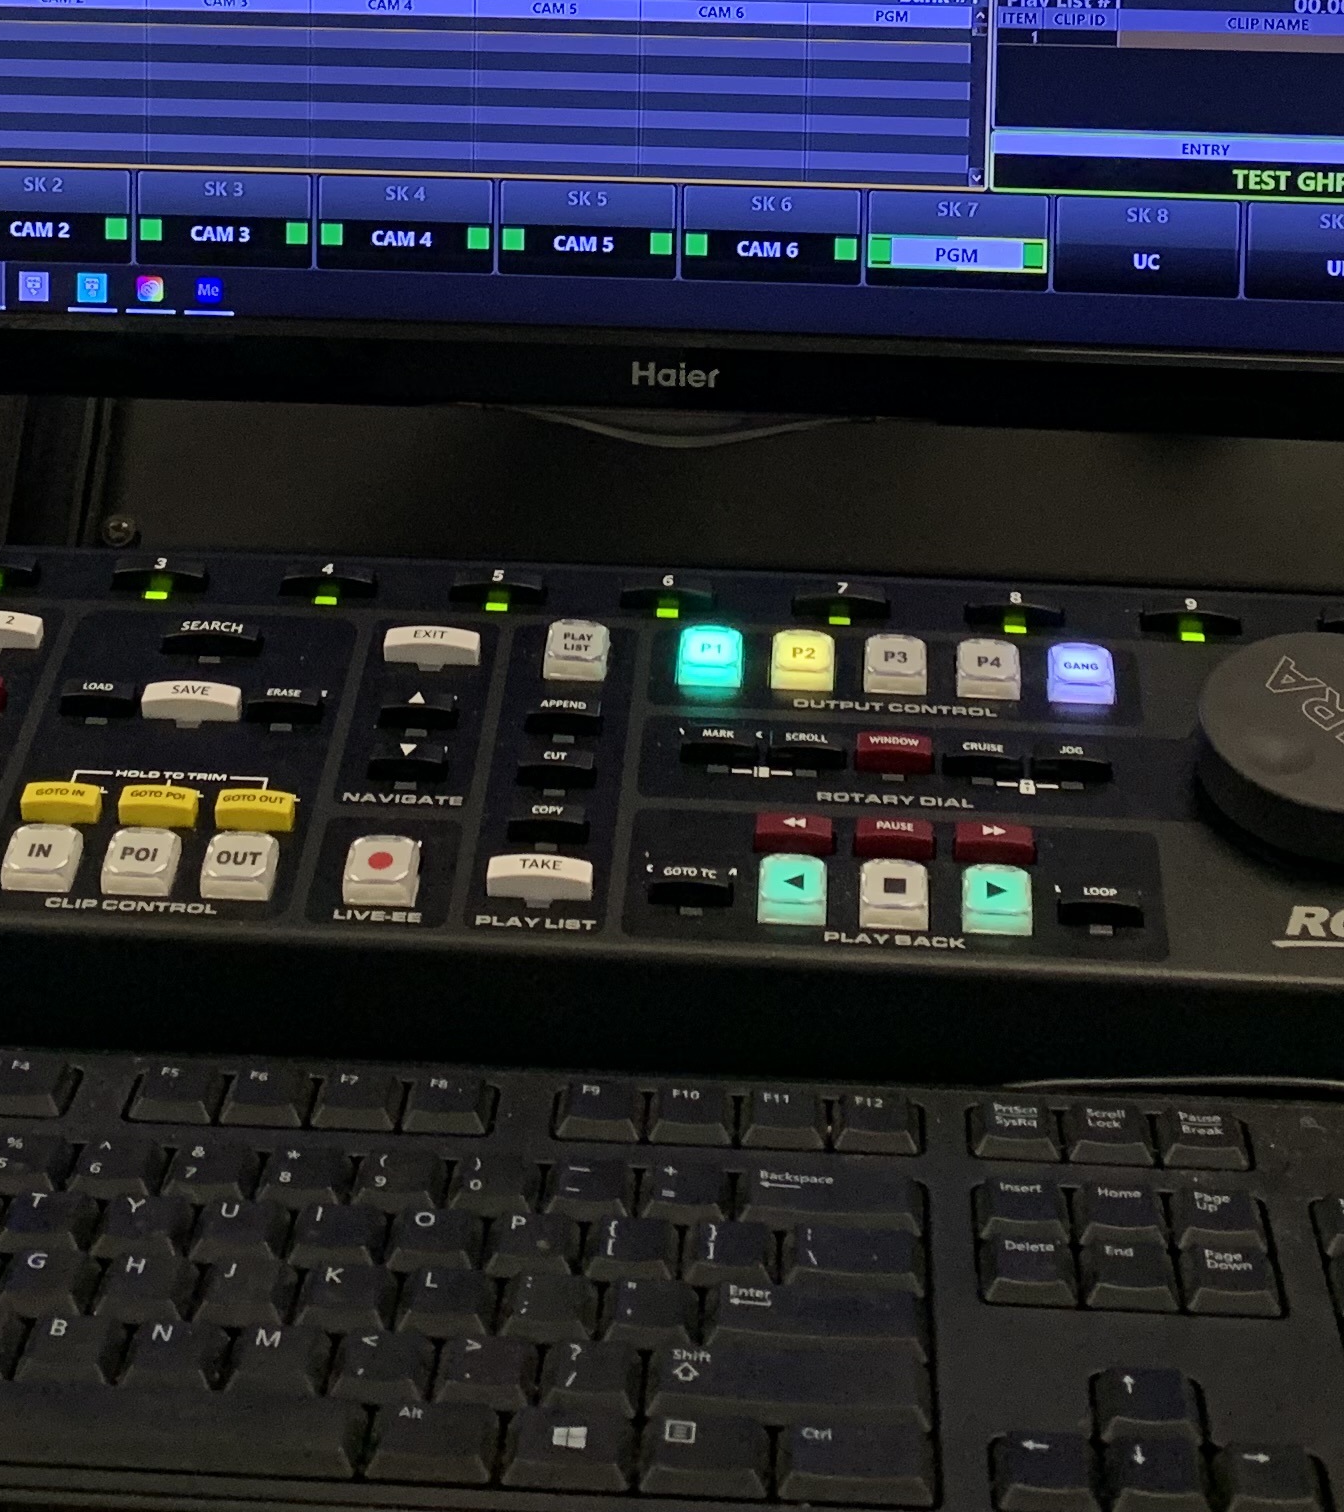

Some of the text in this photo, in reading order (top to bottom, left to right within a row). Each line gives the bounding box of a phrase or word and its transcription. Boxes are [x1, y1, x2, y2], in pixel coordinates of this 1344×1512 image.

[1227, 17, 1310, 31] CLIP NAME
[1181, 141, 1231, 157] ENTRY
[1233, 170, 1290, 192] TEST
[935, 246, 979, 264] PGM
[1133, 253, 1161, 272] UC
[632, 362, 720, 389] Haier
[6, 615, 15, 625] 2
[181, 621, 244, 634] SEARCH
[413, 630, 448, 640] EXIT
[563, 632, 593, 643] PLAY
[563, 643, 591, 652] LIST
[791, 646, 817, 660] P2
[883, 650, 908, 665] P3
[976, 656, 1001, 669] P4
[1063, 660, 1099, 671] GANG
[171, 685, 211, 696] SAVE
[793, 698, 998, 718] OUTPUT CONTROL
[869, 735, 920, 747] WINDOW
[343, 792, 464, 807] NAVIGATE
[816, 791, 974, 809] ROTARY DIAL
[876, 820, 914, 833] PAUSE
[27, 842, 53, 859] IN
[119, 847, 159, 863] POI
[216, 850, 262, 866] OUT
[519, 858, 563, 871] TAKE
[1083, 886, 1118, 897] LOOP
[45, 897, 217, 915] CLIP CONTROL
[333, 908, 422, 923] LIVE-EE
[475, 914, 597, 931] PLAY LIST
[824, 931, 966, 950] PLAY BACK
[760, 1171, 835, 1185] Backspace
[999, 1182, 1042, 1195] Insert
[1097, 1187, 1141, 1200] Home
[1004, 1241, 1055, 1254] Delete
[1104, 1246, 1134, 1258] End
[729, 1285, 771, 1300] Enter
[801, 1427, 832, 1441] Ctrl
